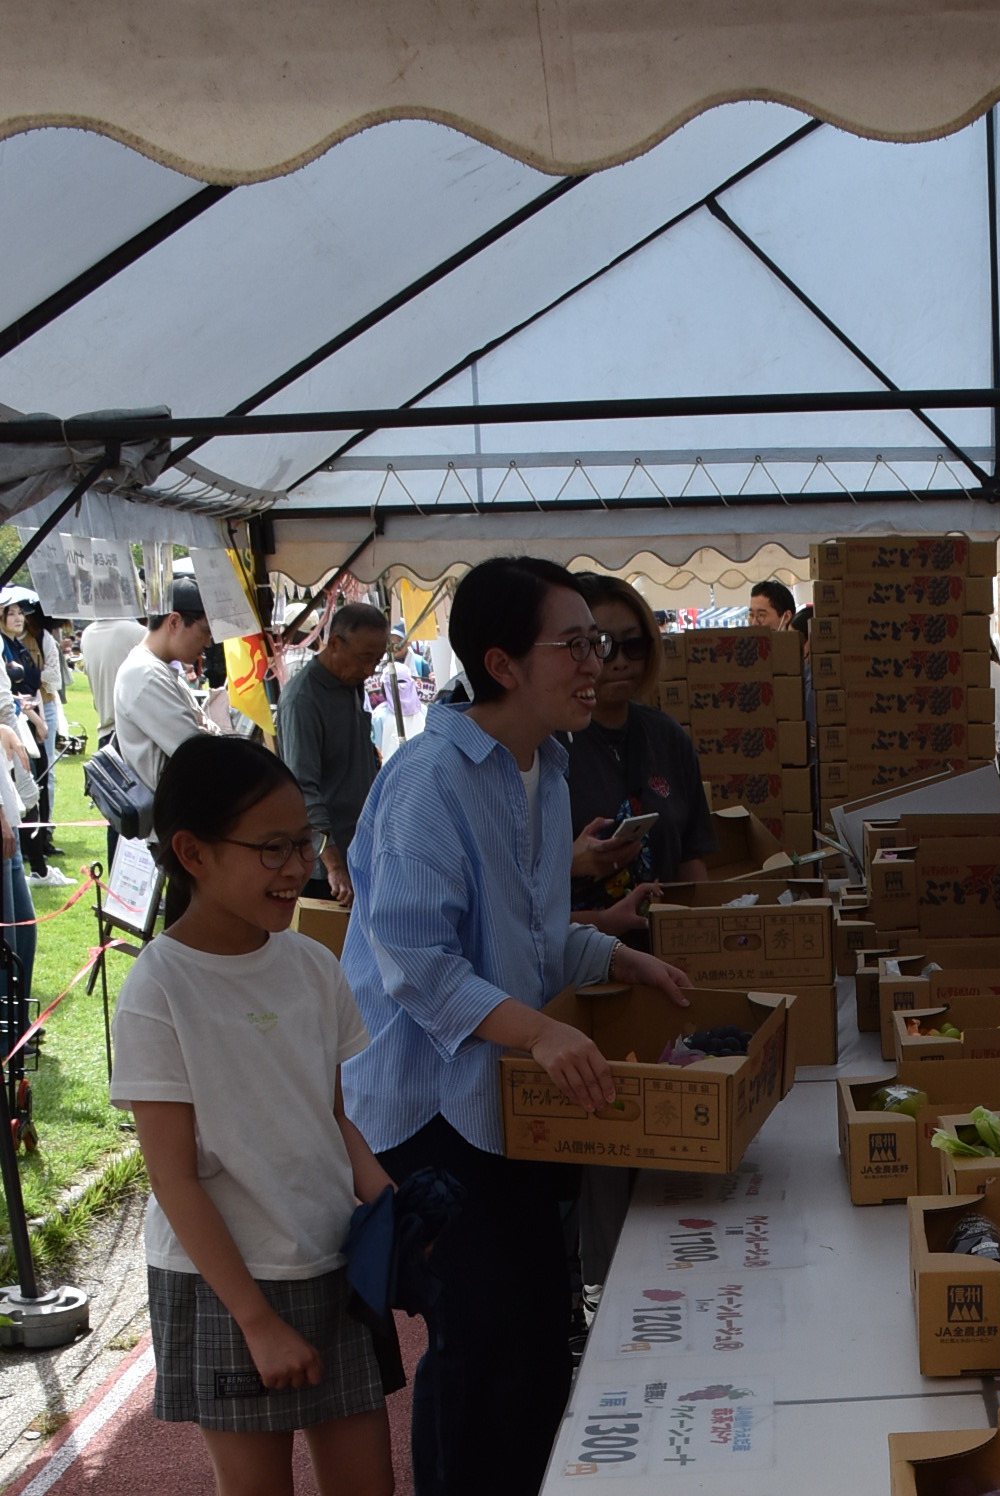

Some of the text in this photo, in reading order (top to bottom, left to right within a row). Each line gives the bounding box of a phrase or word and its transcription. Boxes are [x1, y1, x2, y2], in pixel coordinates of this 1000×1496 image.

[694, 967, 756, 981] JA信州うえだ
[693, 1104, 710, 1126] 8
[554, 1139, 631, 1157] JA信州うえだ
[949, 1287, 981, 1303] 信州
[934, 1326, 999, 1337] JA全農長野
